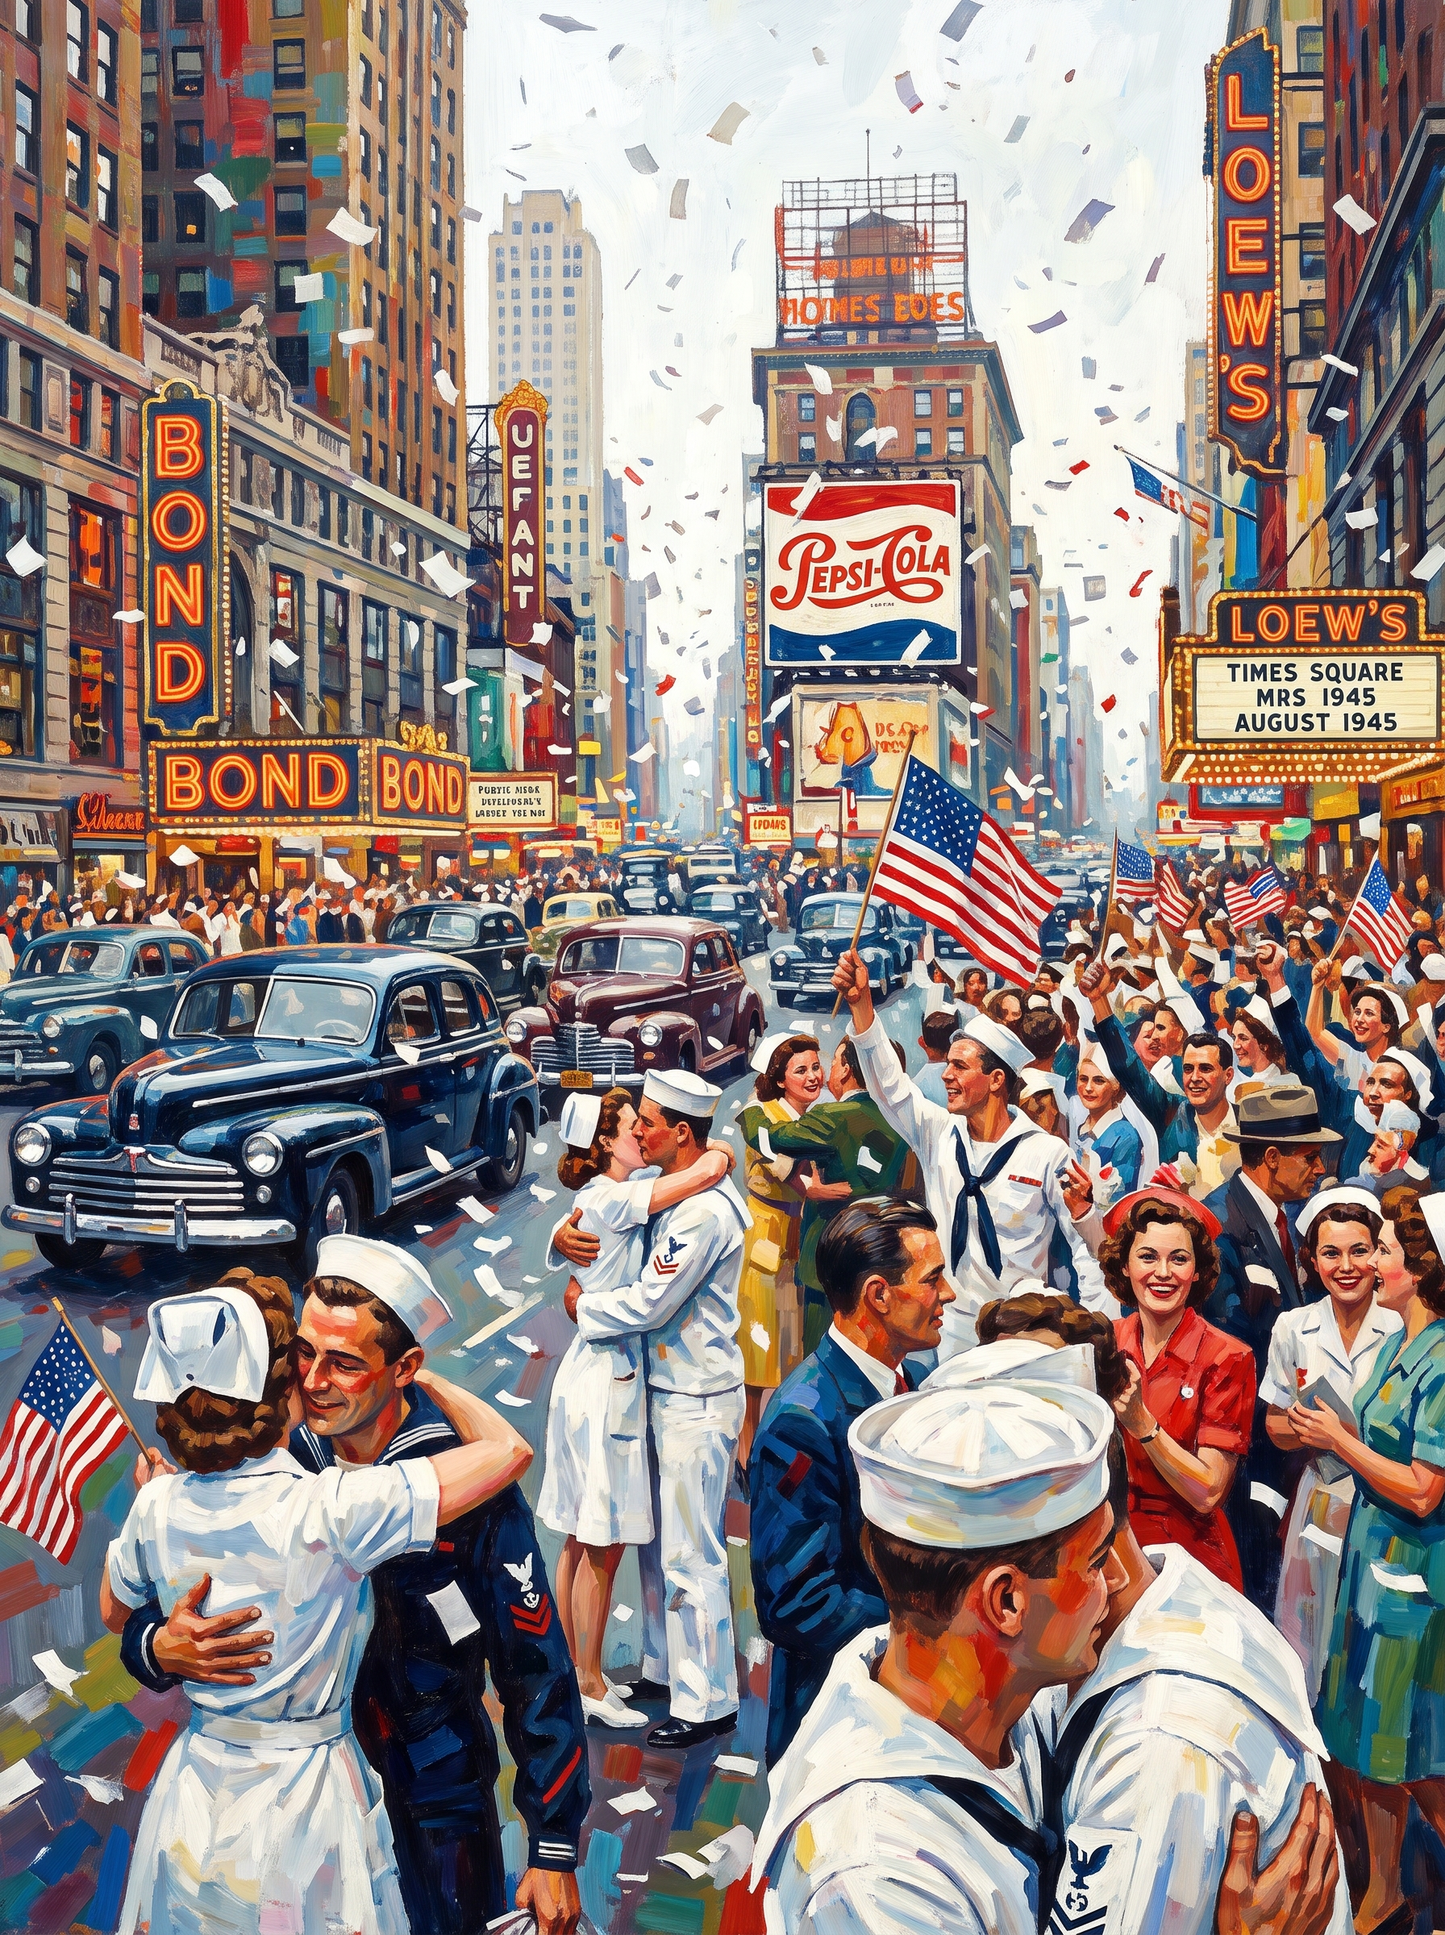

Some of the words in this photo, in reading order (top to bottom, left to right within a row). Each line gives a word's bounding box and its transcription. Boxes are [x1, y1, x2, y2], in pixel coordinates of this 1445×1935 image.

[1221, 71, 1274, 423] LOEW'S
[511, 423, 534, 610] UEFANT
[150, 413, 208, 705] BOND
[1231, 599, 1409, 643] LOEW'S
[1227, 662, 1299, 682] TIMES
[1309, 662, 1404, 684] SQUARE
[1256, 688, 1306, 707] MRS
[1322, 687, 1376, 707] 1945
[1234, 713, 1331, 733] AUGUST
[1342, 712, 1398, 732] 1945
[163, 752, 352, 812] BOND
[381, 754, 464, 816] BOND
